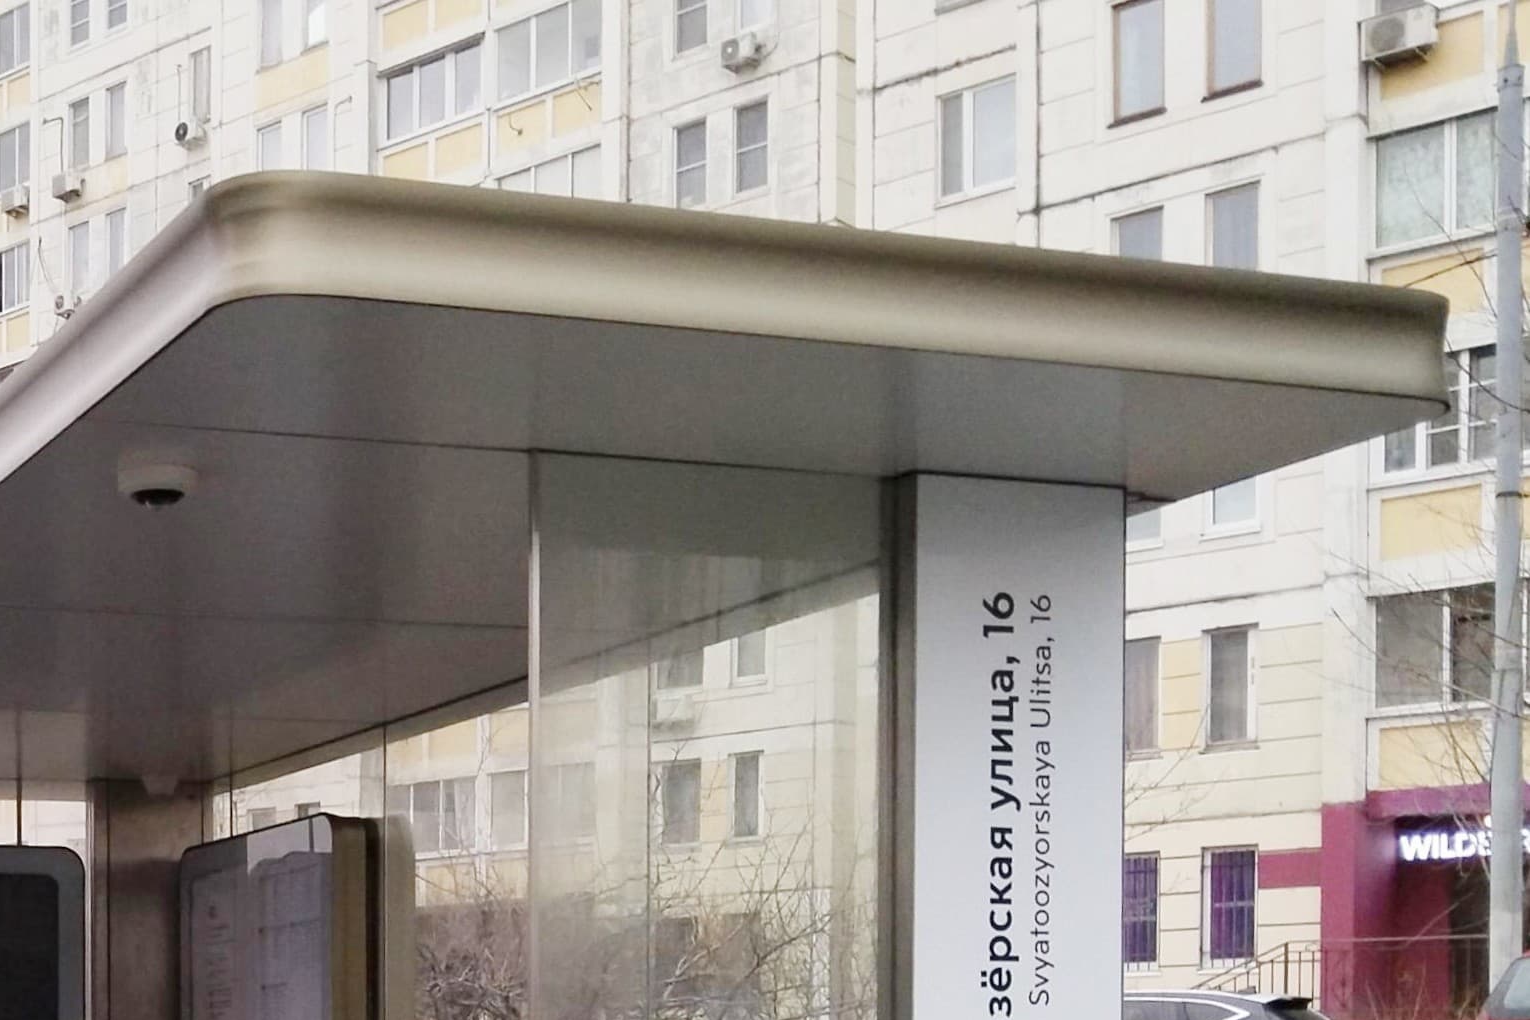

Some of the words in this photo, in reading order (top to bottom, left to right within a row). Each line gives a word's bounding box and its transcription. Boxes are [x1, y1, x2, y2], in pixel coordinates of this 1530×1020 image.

[982, 591, 1015, 638] 16
[1029, 594, 1052, 624] 16
[1029, 636, 1055, 728] Ulitsa,
[990, 655, 1021, 812] улица,
[1028, 740, 1056, 1006] Svyatoozyorskaya
